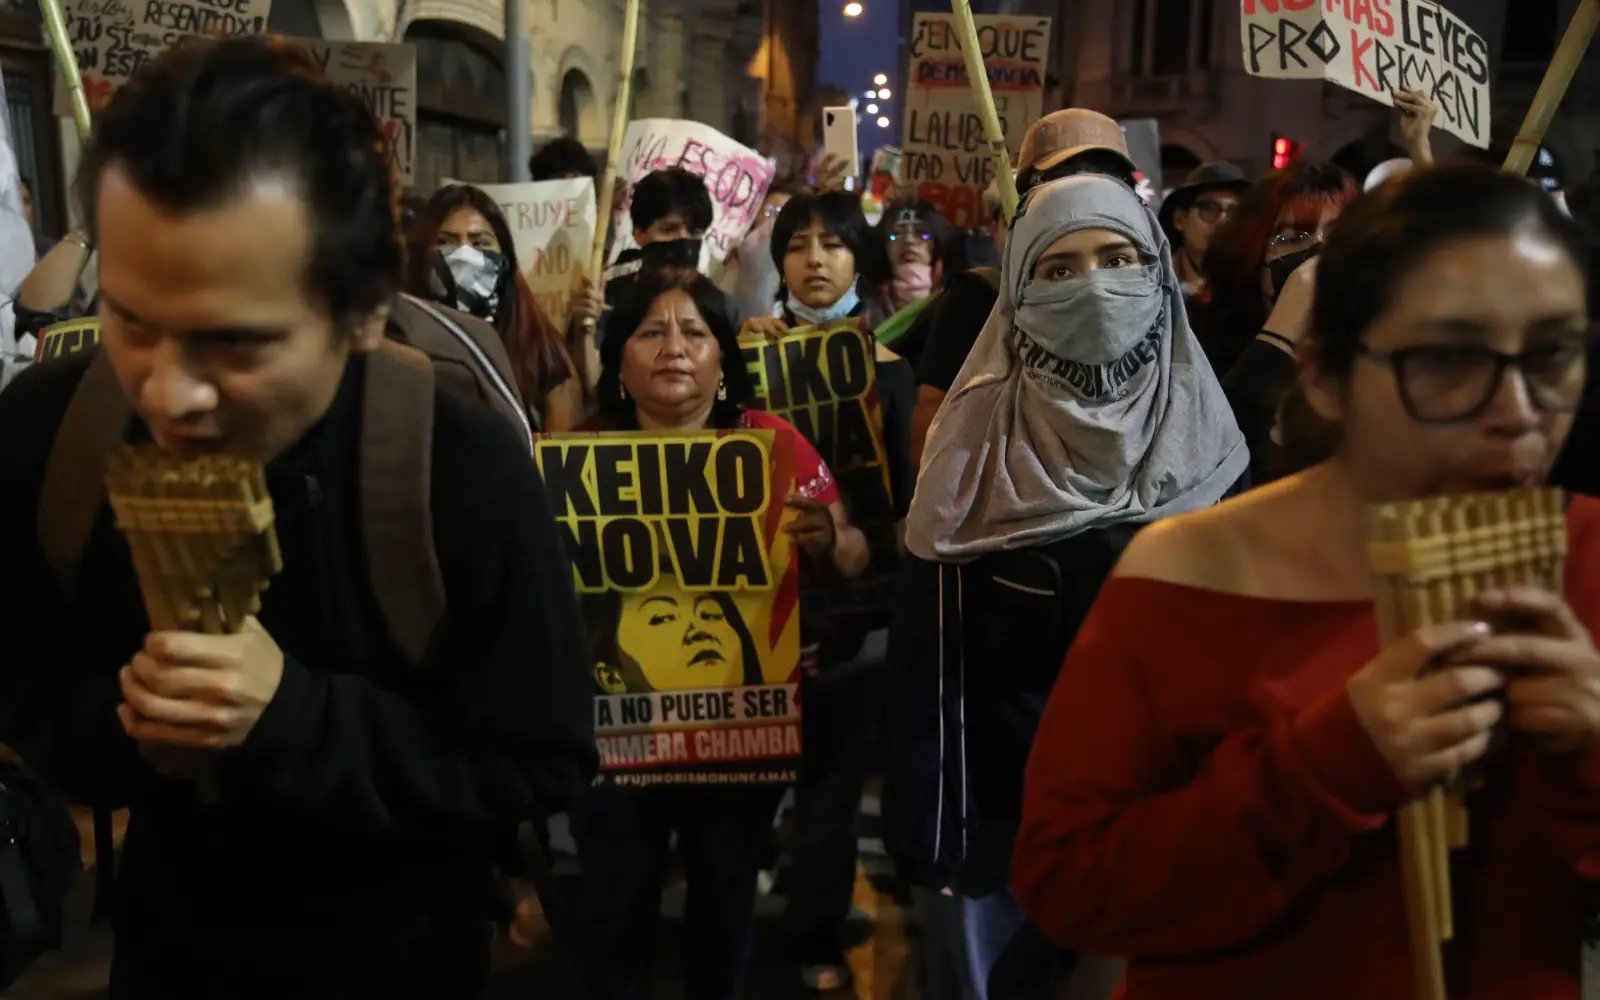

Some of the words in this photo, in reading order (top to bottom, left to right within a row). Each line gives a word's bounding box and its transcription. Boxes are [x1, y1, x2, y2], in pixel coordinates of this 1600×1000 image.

[1249, 18, 1341, 73] PRO
[1401, 0, 1487, 85] LEYES
[500, 198, 579, 231] TRUYE
[533, 243, 571, 277] NO
[742, 330, 869, 412] EIKO
[539, 438, 766, 516] KEIKO
[596, 698, 613, 727] A
[620, 697, 653, 725] NO
[661, 691, 735, 722] PUEDE
[743, 688, 788, 718] SER
[596, 731, 689, 766] RIMERA
[694, 724, 802, 759] CHAMBA
